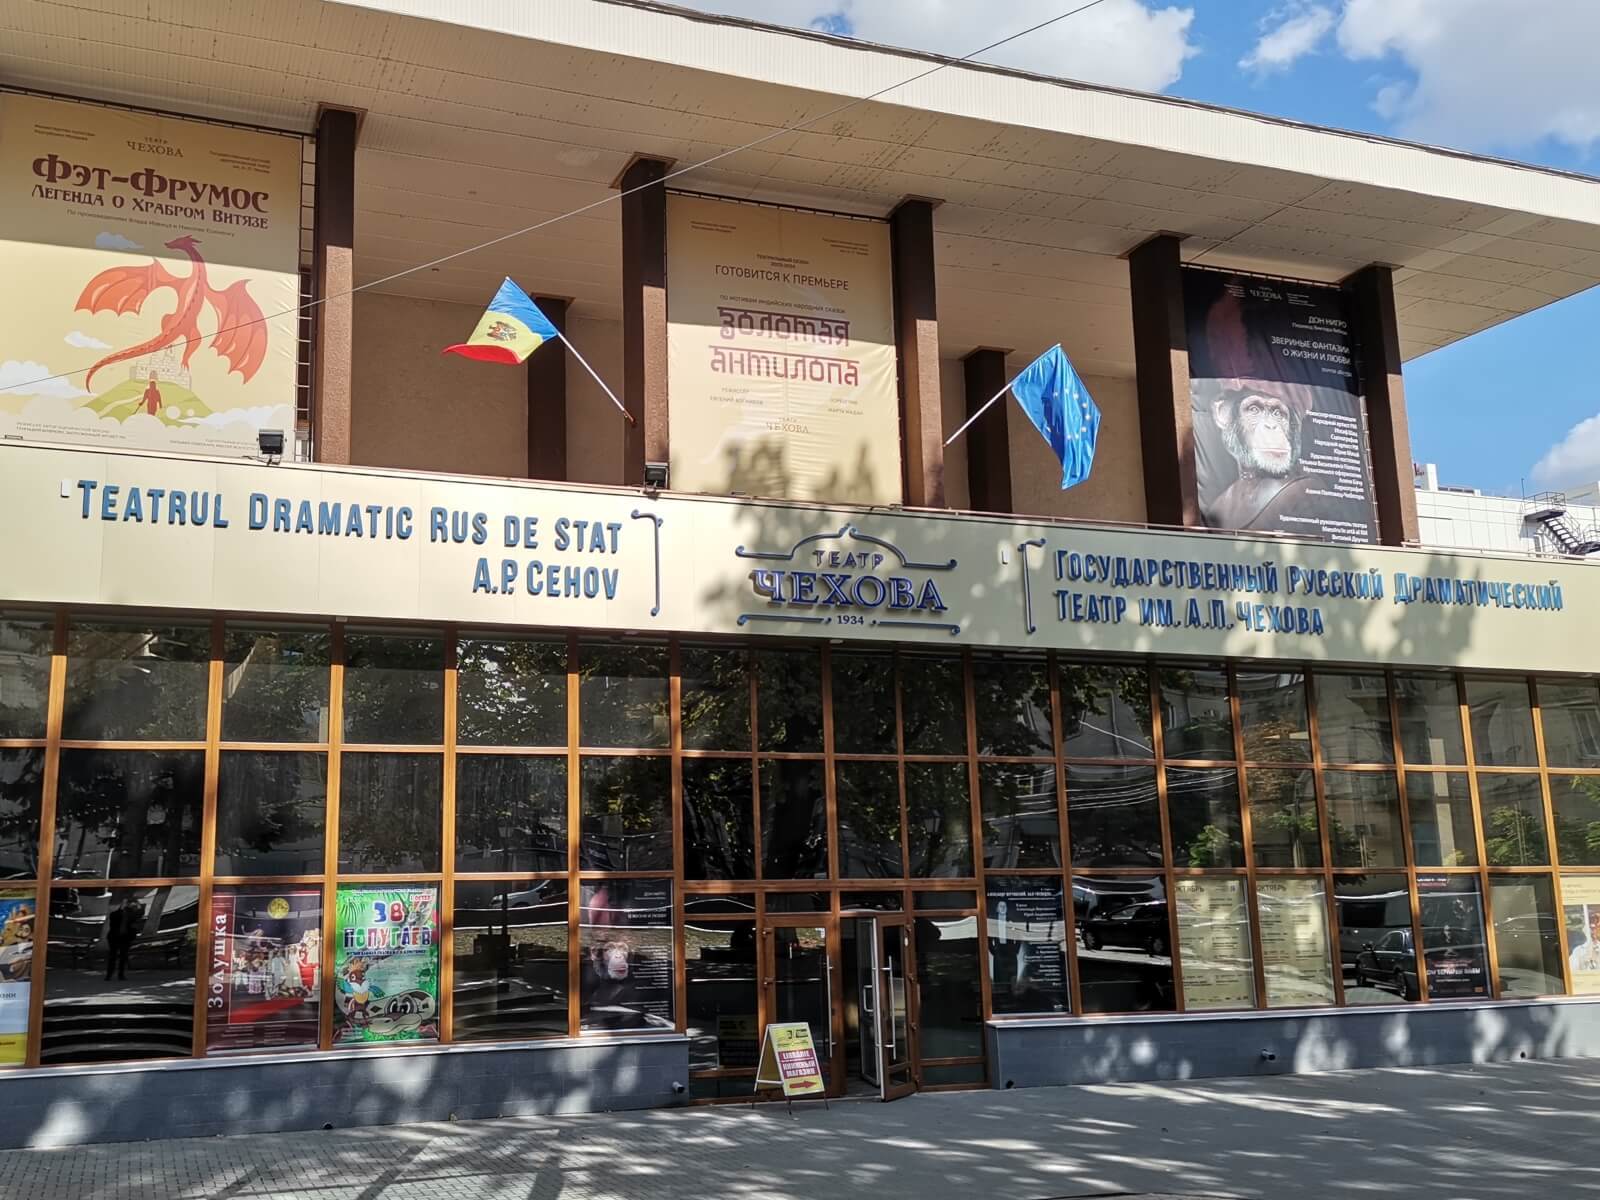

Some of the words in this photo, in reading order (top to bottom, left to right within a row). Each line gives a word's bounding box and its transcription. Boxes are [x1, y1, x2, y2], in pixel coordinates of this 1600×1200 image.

[127, 141, 184, 157] ЧЕХОВА
[32, 184, 104, 206] ЛЕГЕНДА
[112, 195, 124, 209] О
[132, 198, 205, 220] ХРАБРОМ
[715, 264, 780, 281] ГОТОВИТСЯ
[782, 273, 790, 283] К
[793, 274, 849, 290] ПРЕМЬЕРЕ
[1271, 336, 1312, 348] ЗВЕРИНЫЕ
[1282, 348, 1290, 356] О
[1290, 350, 1319, 360] ЖИЗНИ
[1319, 353, 1326, 361] И
[77, 479, 229, 529] TEATRUL
[248, 493, 414, 540] DRAMATIC
[430, 506, 488, 545] RUS
[503, 515, 539, 549] DE
[554, 517, 623, 554] STAT
[812, 550, 884, 569] ТЕАТР
[472, 557, 519, 595] A.P.
[526, 560, 619, 600] CEHOV
[750, 569, 948, 613] ЧЕХОВА
[1055, 550, 1279, 593] ГОСУДАРСТВЕННЫЙ
[1287, 565, 1384, 600] РУССКИЙ
[1393, 572, 1564, 611] ДРАМАТИЧЕСКИЙ
[836, 615, 864, 626] 1934
[1053, 589, 1127, 623] ТЕАТР
[1138, 597, 1182, 627] ИМ.
[1185, 598, 1235, 630] А.П.
[1236, 599, 1324, 636] ЧЕХОВА
[373, 901, 405, 925] 38
[343, 926, 433, 949] ПОПУГАЕВ
